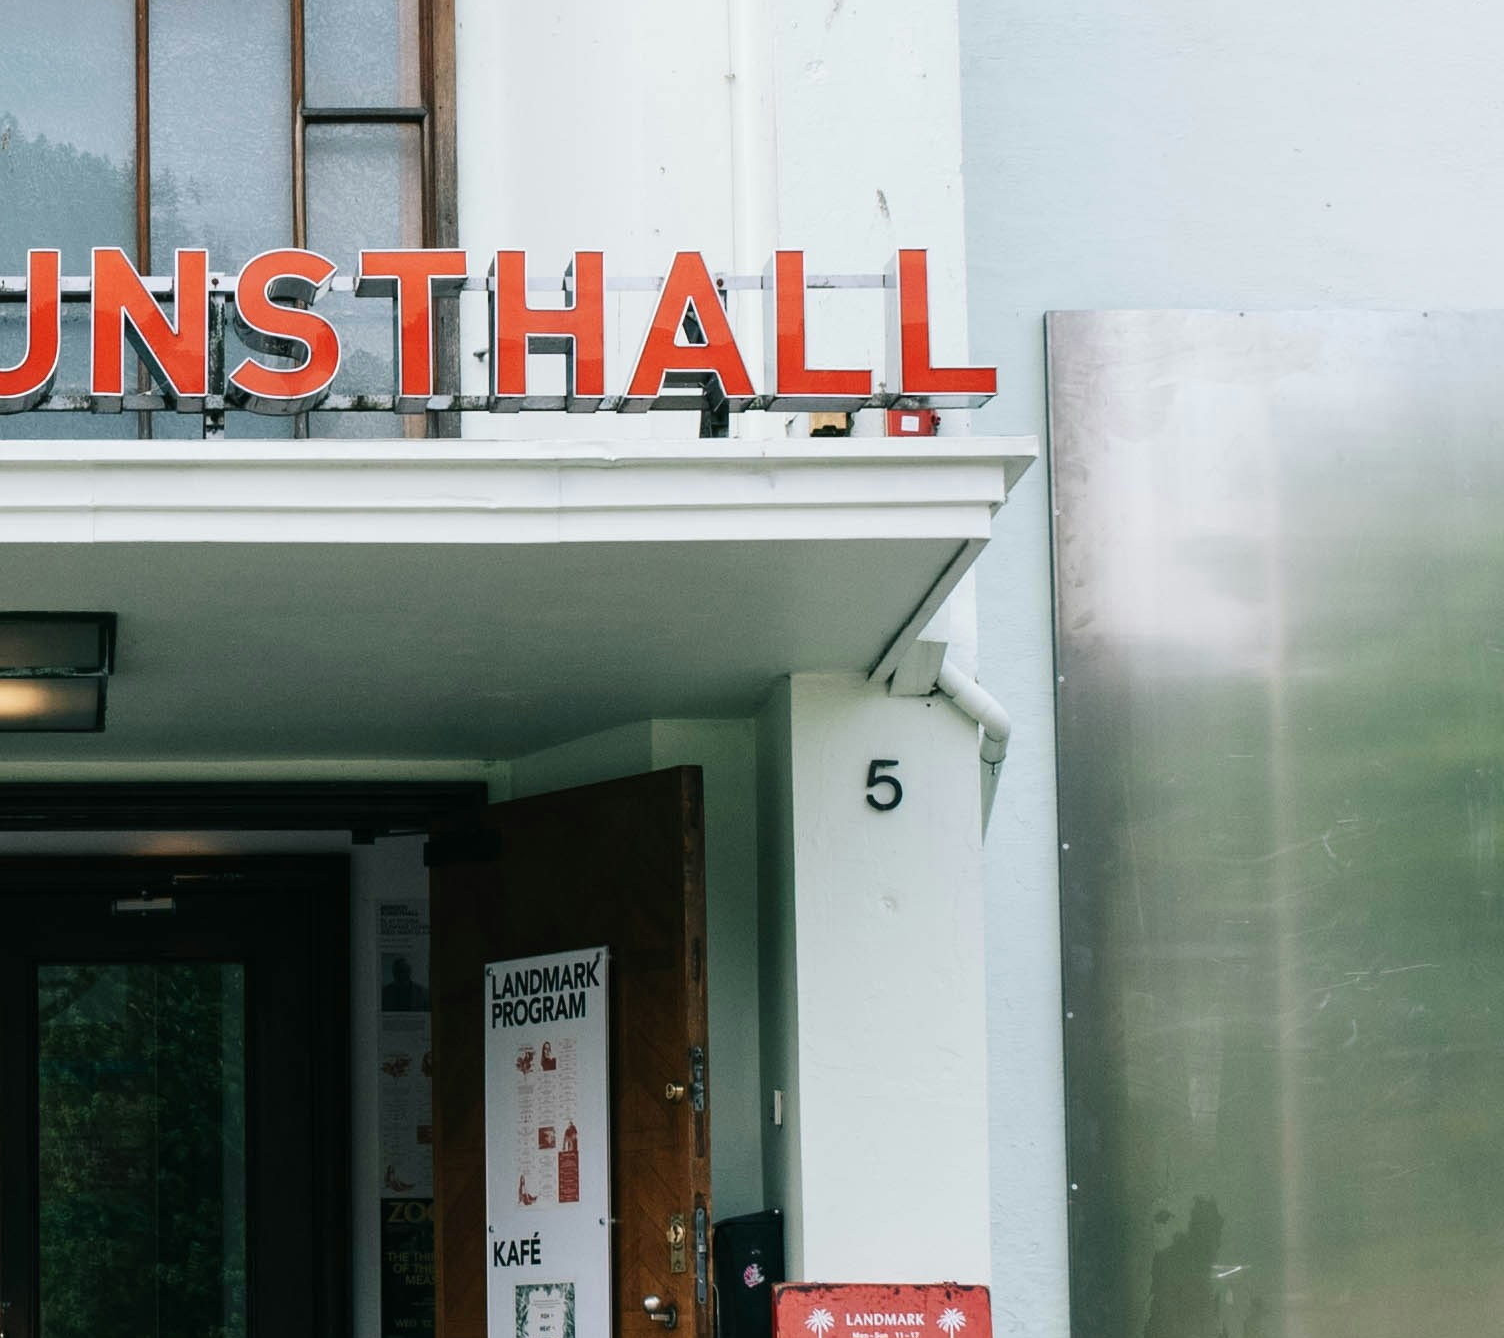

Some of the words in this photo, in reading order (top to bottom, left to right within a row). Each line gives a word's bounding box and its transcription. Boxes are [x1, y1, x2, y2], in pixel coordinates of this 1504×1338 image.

[866, 759, 904, 812] 5
[492, 960, 600, 1000] LANDMARK
[492, 991, 586, 1029] PROGRAM
[494, 1231, 542, 1267] KAFÉ
[845, 1313, 925, 1327] LANDMARK
